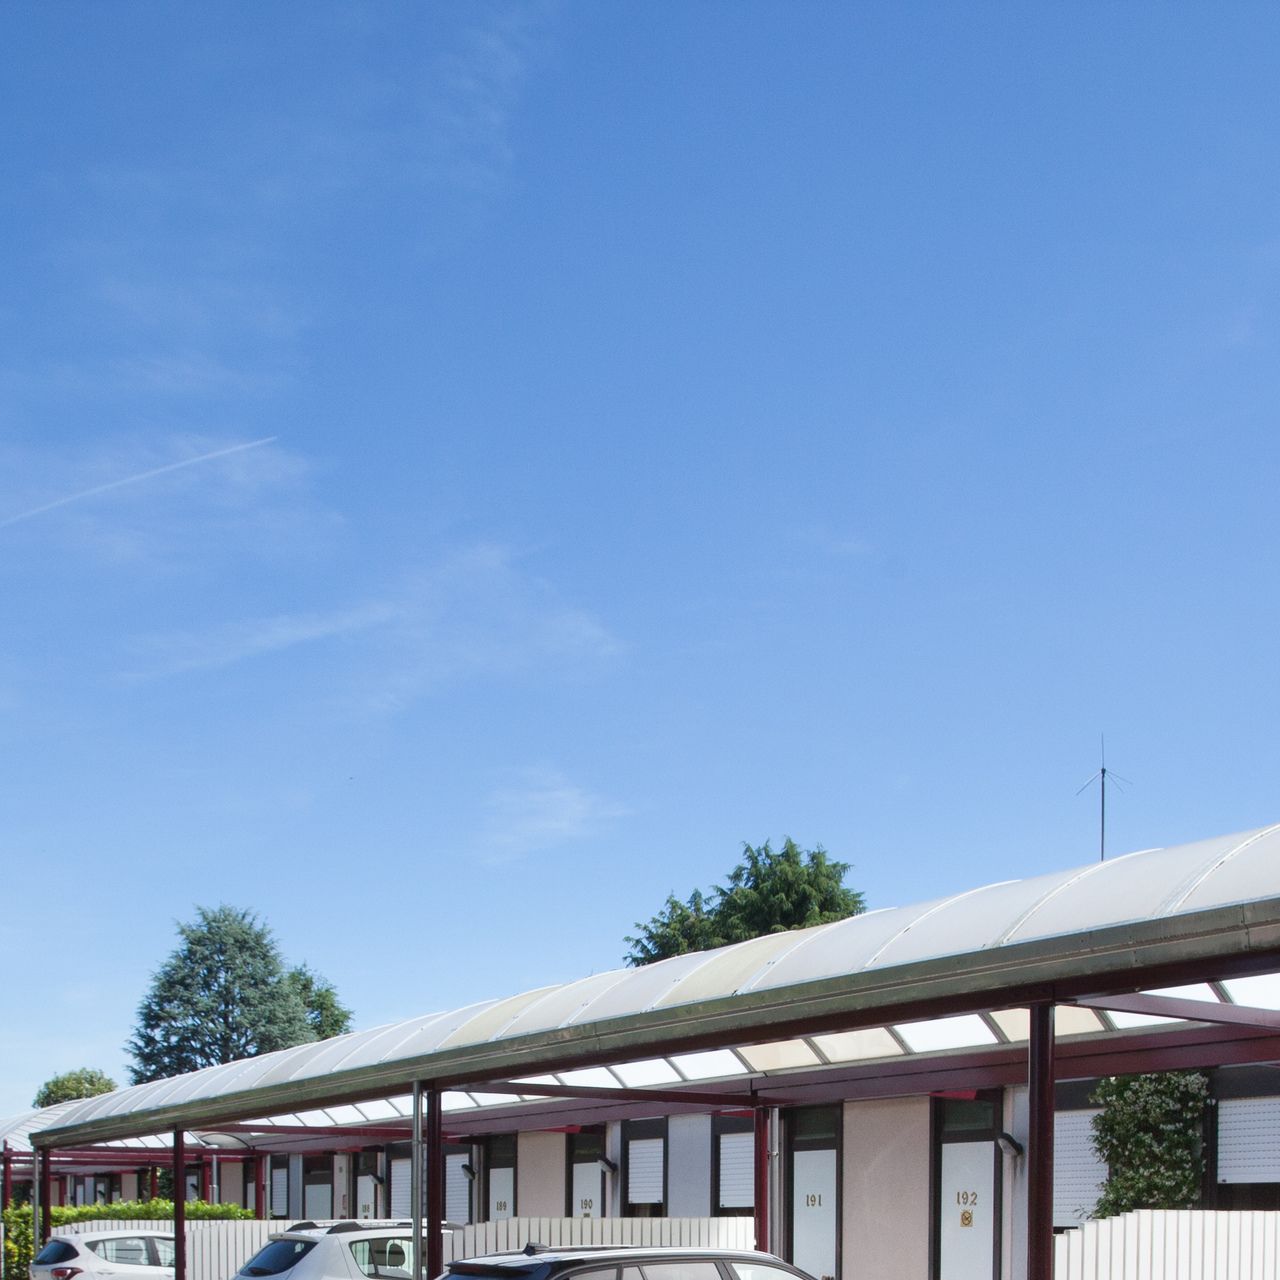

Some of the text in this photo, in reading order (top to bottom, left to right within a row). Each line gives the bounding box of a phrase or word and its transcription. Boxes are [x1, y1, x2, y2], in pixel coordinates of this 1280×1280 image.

[580, 1198, 593, 1210] 190
[806, 1193, 822, 1207] 191
[956, 1191, 978, 1206] 192
